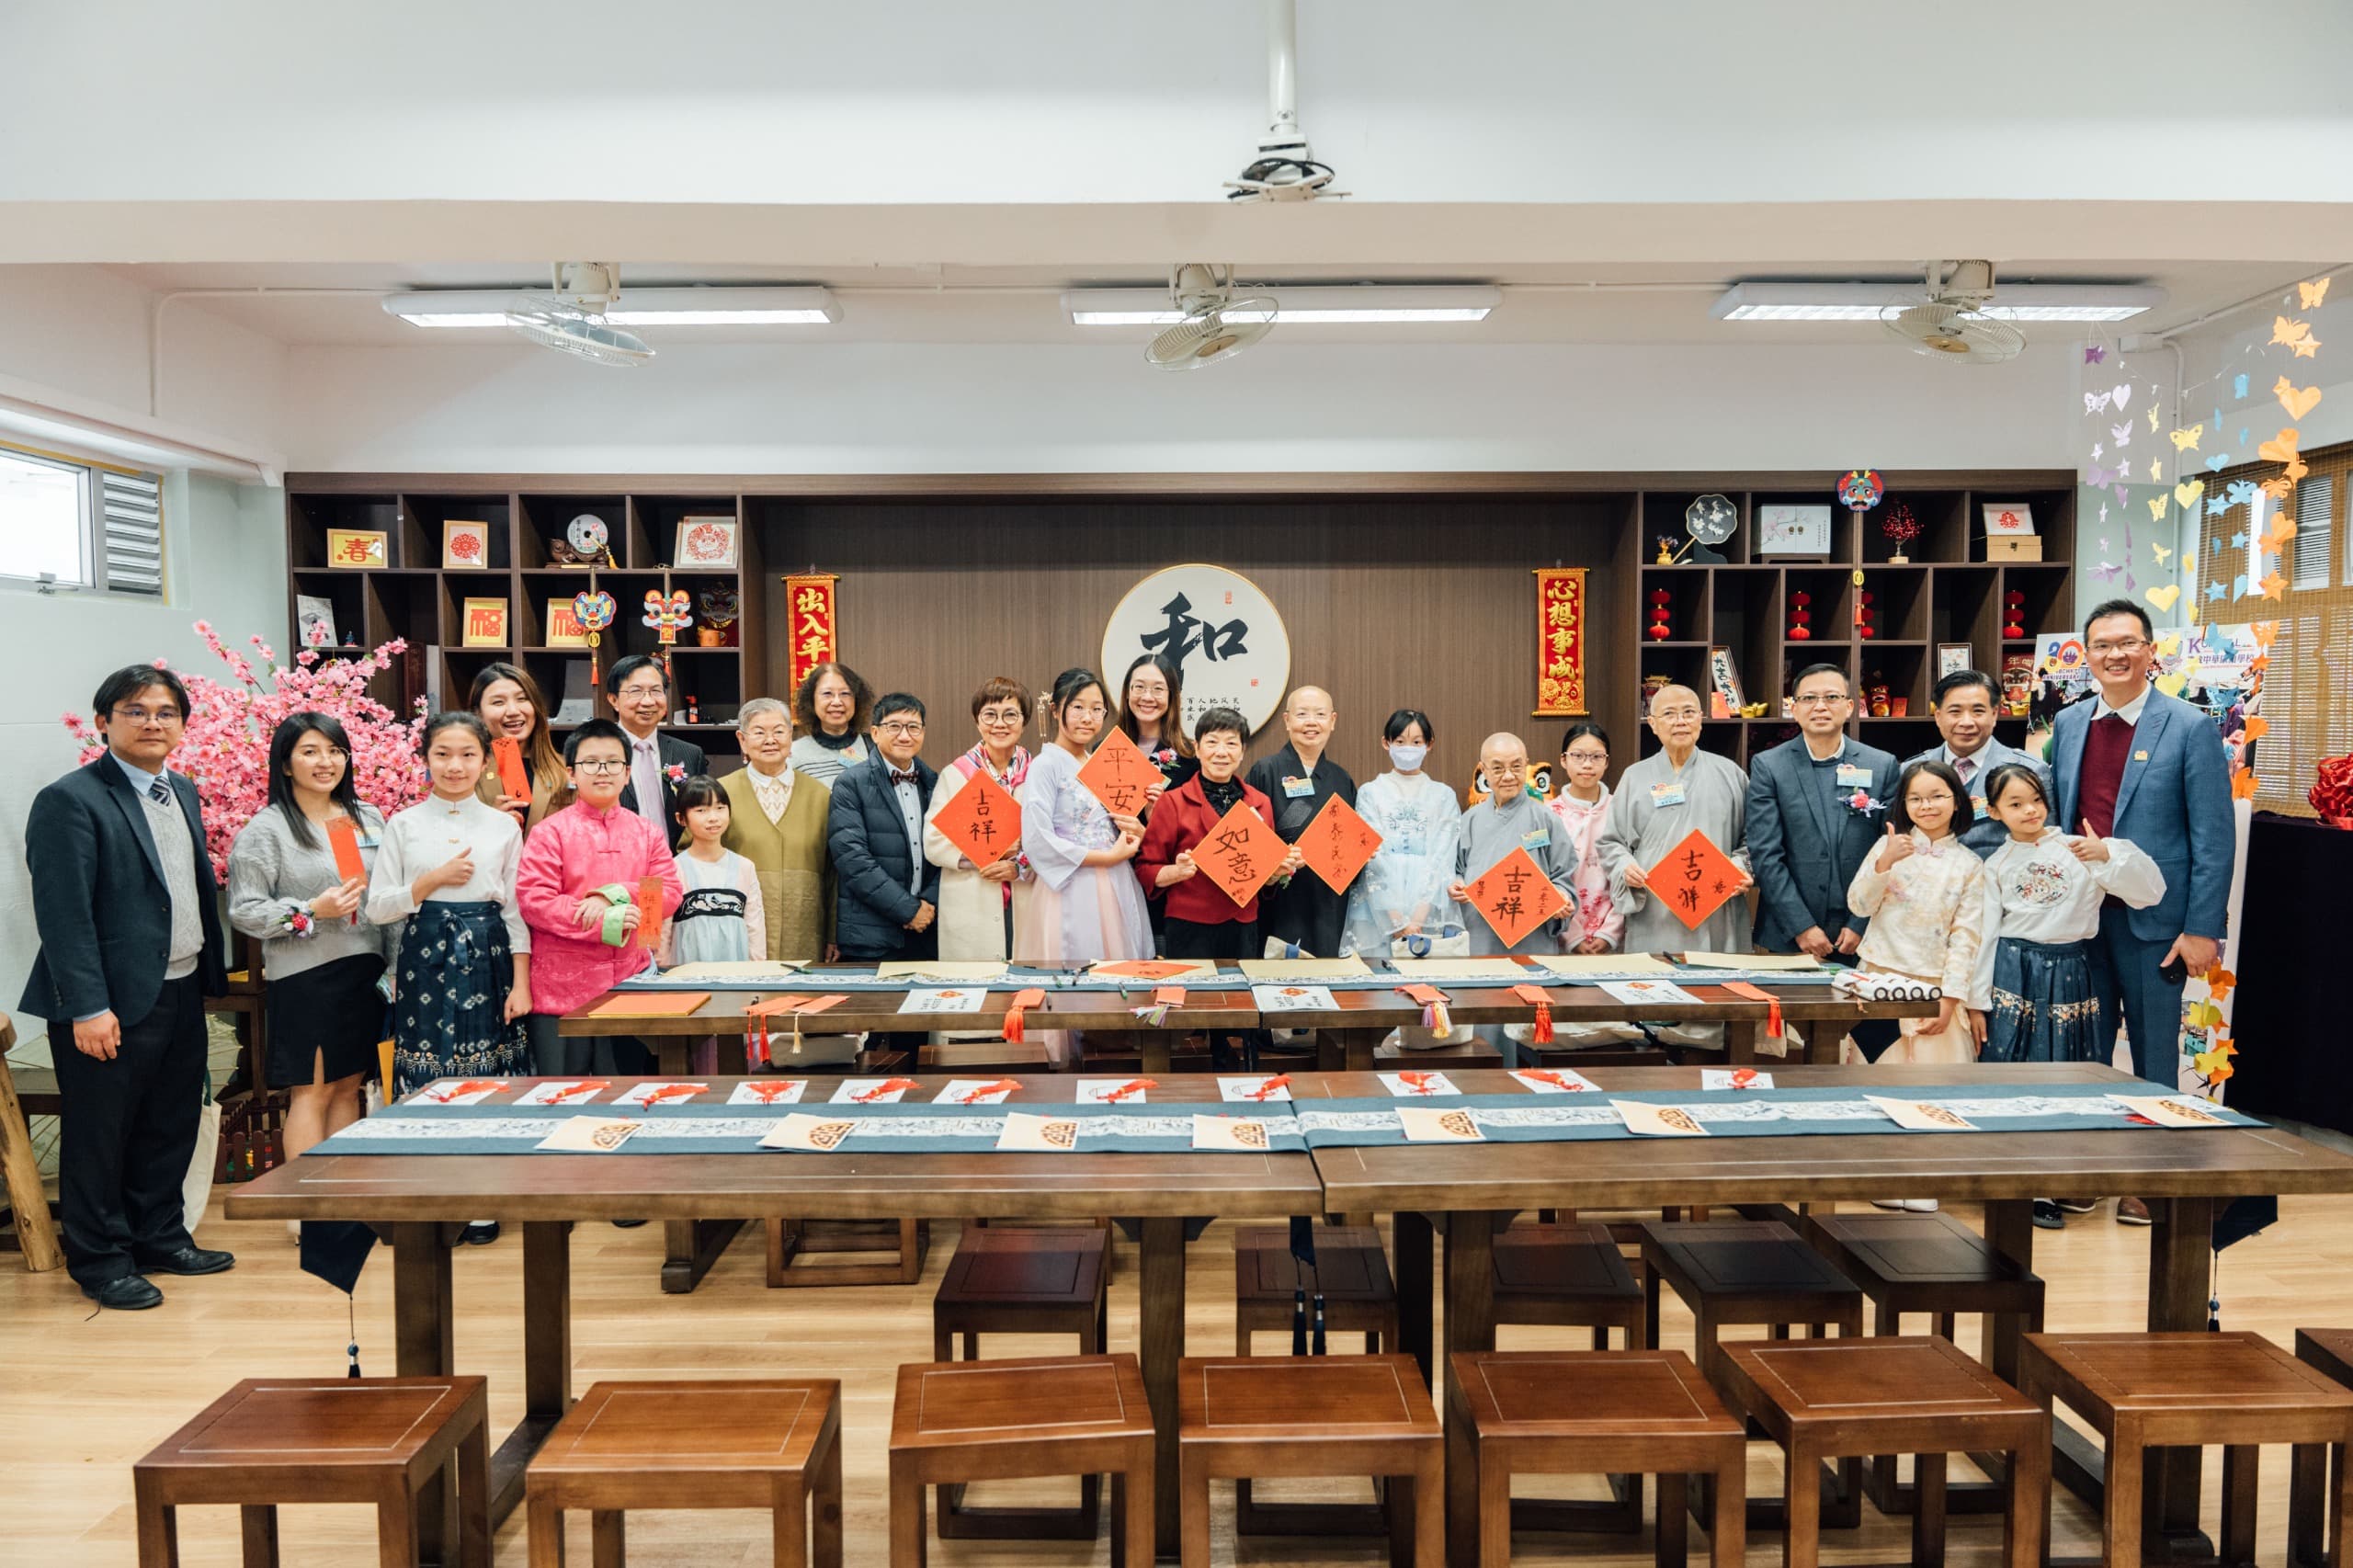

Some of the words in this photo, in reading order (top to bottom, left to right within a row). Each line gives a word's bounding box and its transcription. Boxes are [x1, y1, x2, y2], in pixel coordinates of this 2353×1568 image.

[344, 539, 372, 562] 春
[1140, 591, 1248, 691] 和
[1547, 580, 1577, 680] 心想事成
[1104, 747, 1136, 812] 平安
[969, 788, 997, 845] 吉祥
[1213, 826, 1257, 884] 如意
[1678, 849, 1705, 913] 吉祥
[1491, 865, 1532, 929] 吉祥
